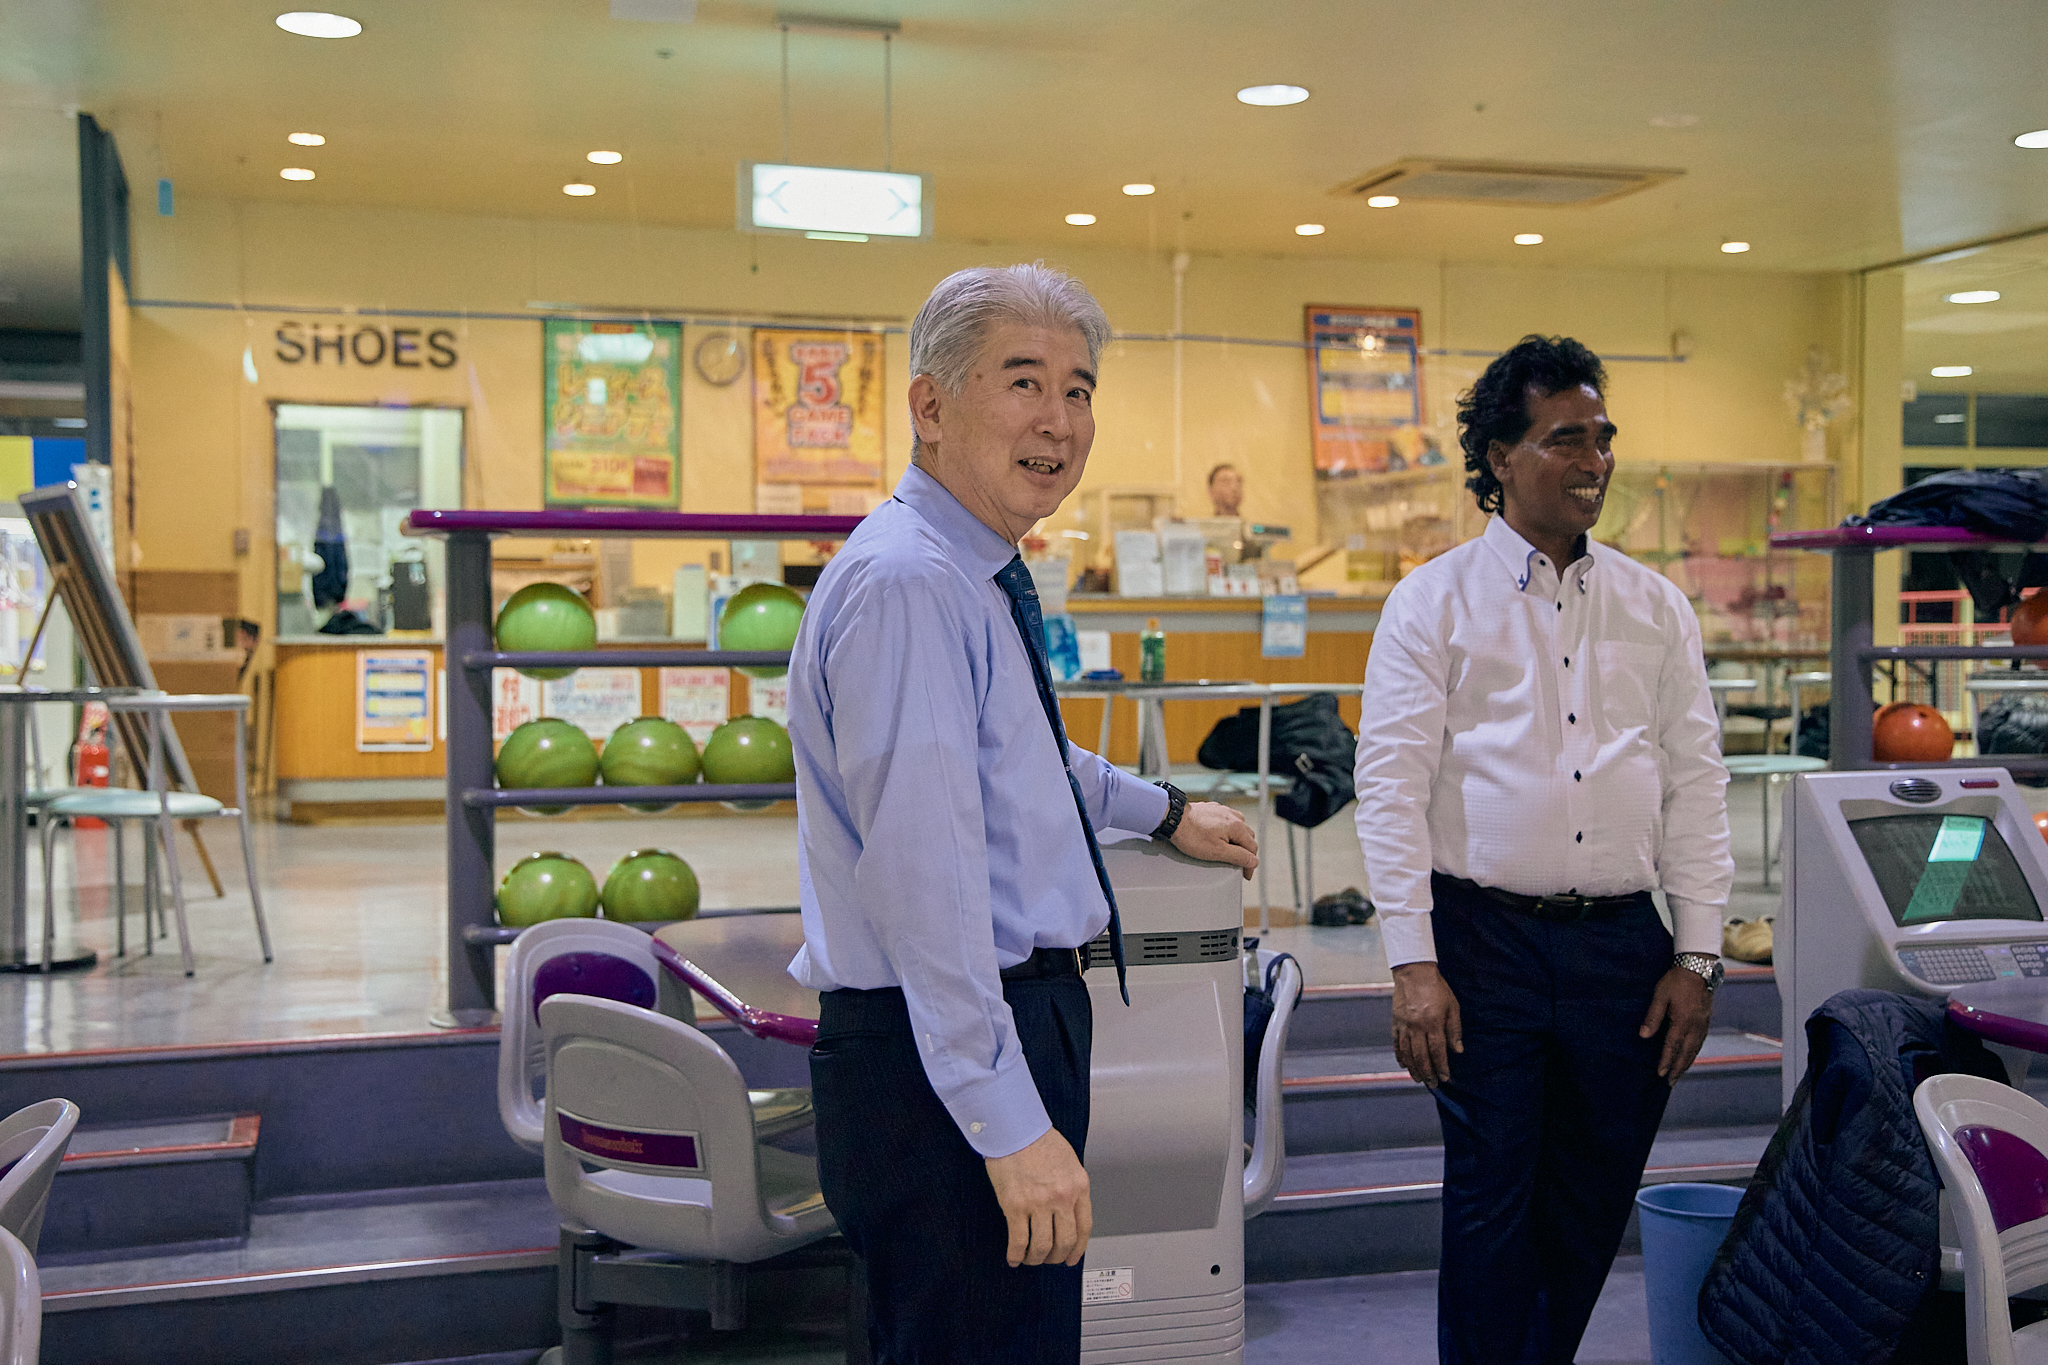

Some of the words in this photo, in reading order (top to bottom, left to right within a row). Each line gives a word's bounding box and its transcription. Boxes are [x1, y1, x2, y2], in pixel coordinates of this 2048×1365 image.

[276, 321, 458, 369] SHOES
[801, 362, 838, 406] 5
[790, 408, 847, 423] GAME
